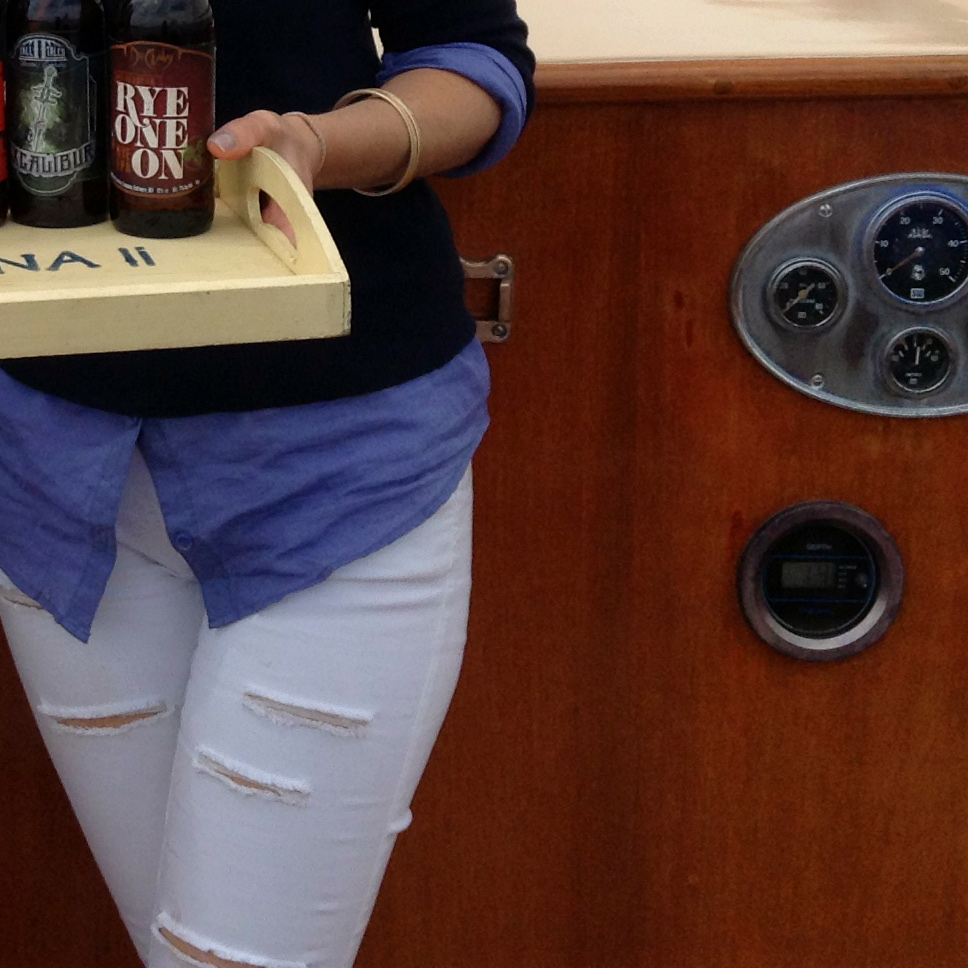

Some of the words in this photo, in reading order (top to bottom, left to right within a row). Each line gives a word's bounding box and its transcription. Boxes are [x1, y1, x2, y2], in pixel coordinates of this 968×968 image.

[116, 80, 189, 127] RYE
[114, 113, 188, 149] ONE
[12, 144, 94, 174] CALIBUR
[131, 148, 186, 180] ON
[900, 216, 911, 225] 20
[932, 216, 944, 225] 30
[947, 239, 959, 248] 40
[939, 267, 950, 276] 50
